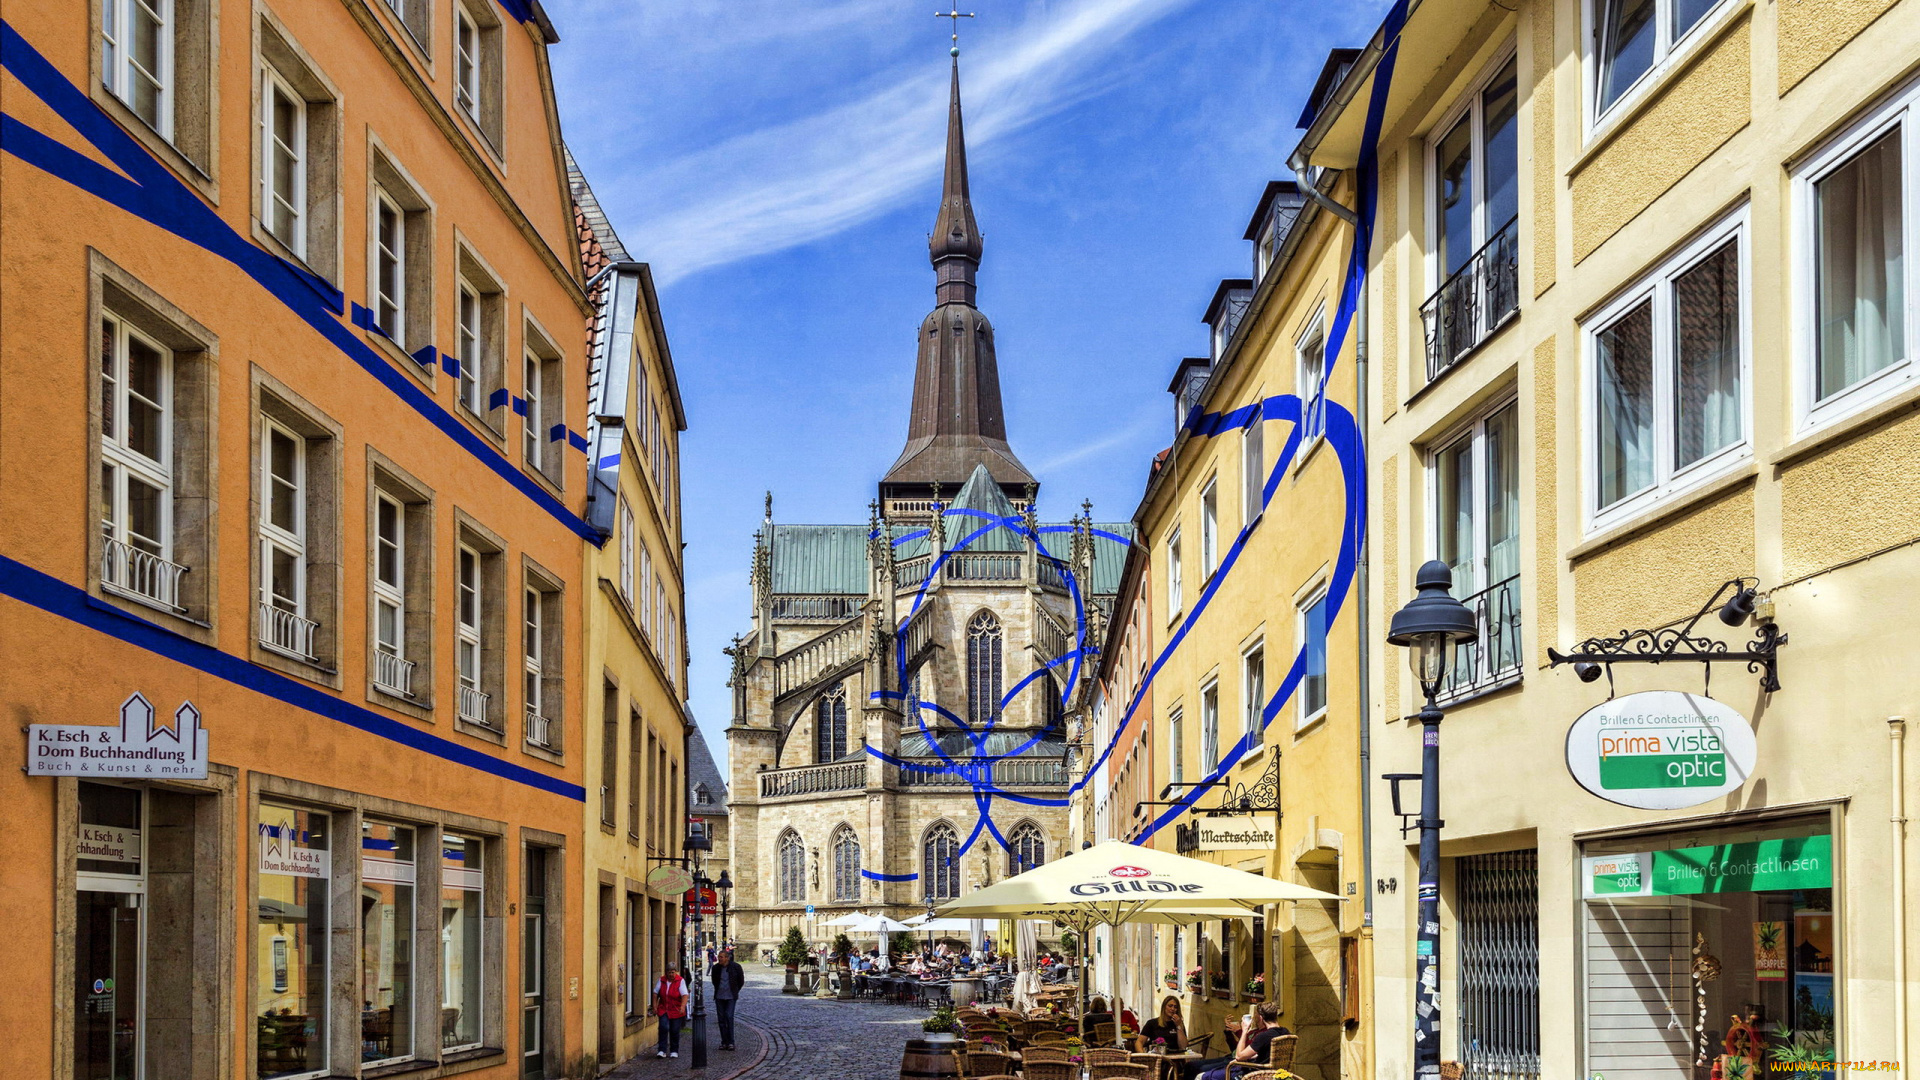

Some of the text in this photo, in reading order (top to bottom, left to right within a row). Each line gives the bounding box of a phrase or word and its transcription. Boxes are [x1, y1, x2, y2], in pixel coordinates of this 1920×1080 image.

[1600, 713, 1720, 726] Brillen & Contactlinsen
[38, 729, 111, 743] K. Esch &
[1601, 729, 1720, 762] prima vista
[38, 745, 186, 764] Dom Buchhandlung
[38, 761, 195, 774] Buch & Kunst & mehr
[1666, 755, 1723, 786] optic
[84, 829, 125, 844] K. Esch &
[1200, 829, 1274, 845] Marktschänke
[300, 851, 313, 862] Esch
[314, 854, 320, 863] &
[264, 860, 320, 878] Dom Buchhandlung
[1594, 858, 1640, 876] prima vista
[1667, 856, 1819, 881] Brillen & Contactlinsen
[1069, 880, 1204, 897] Gilde
[1617, 872, 1641, 892] optic
